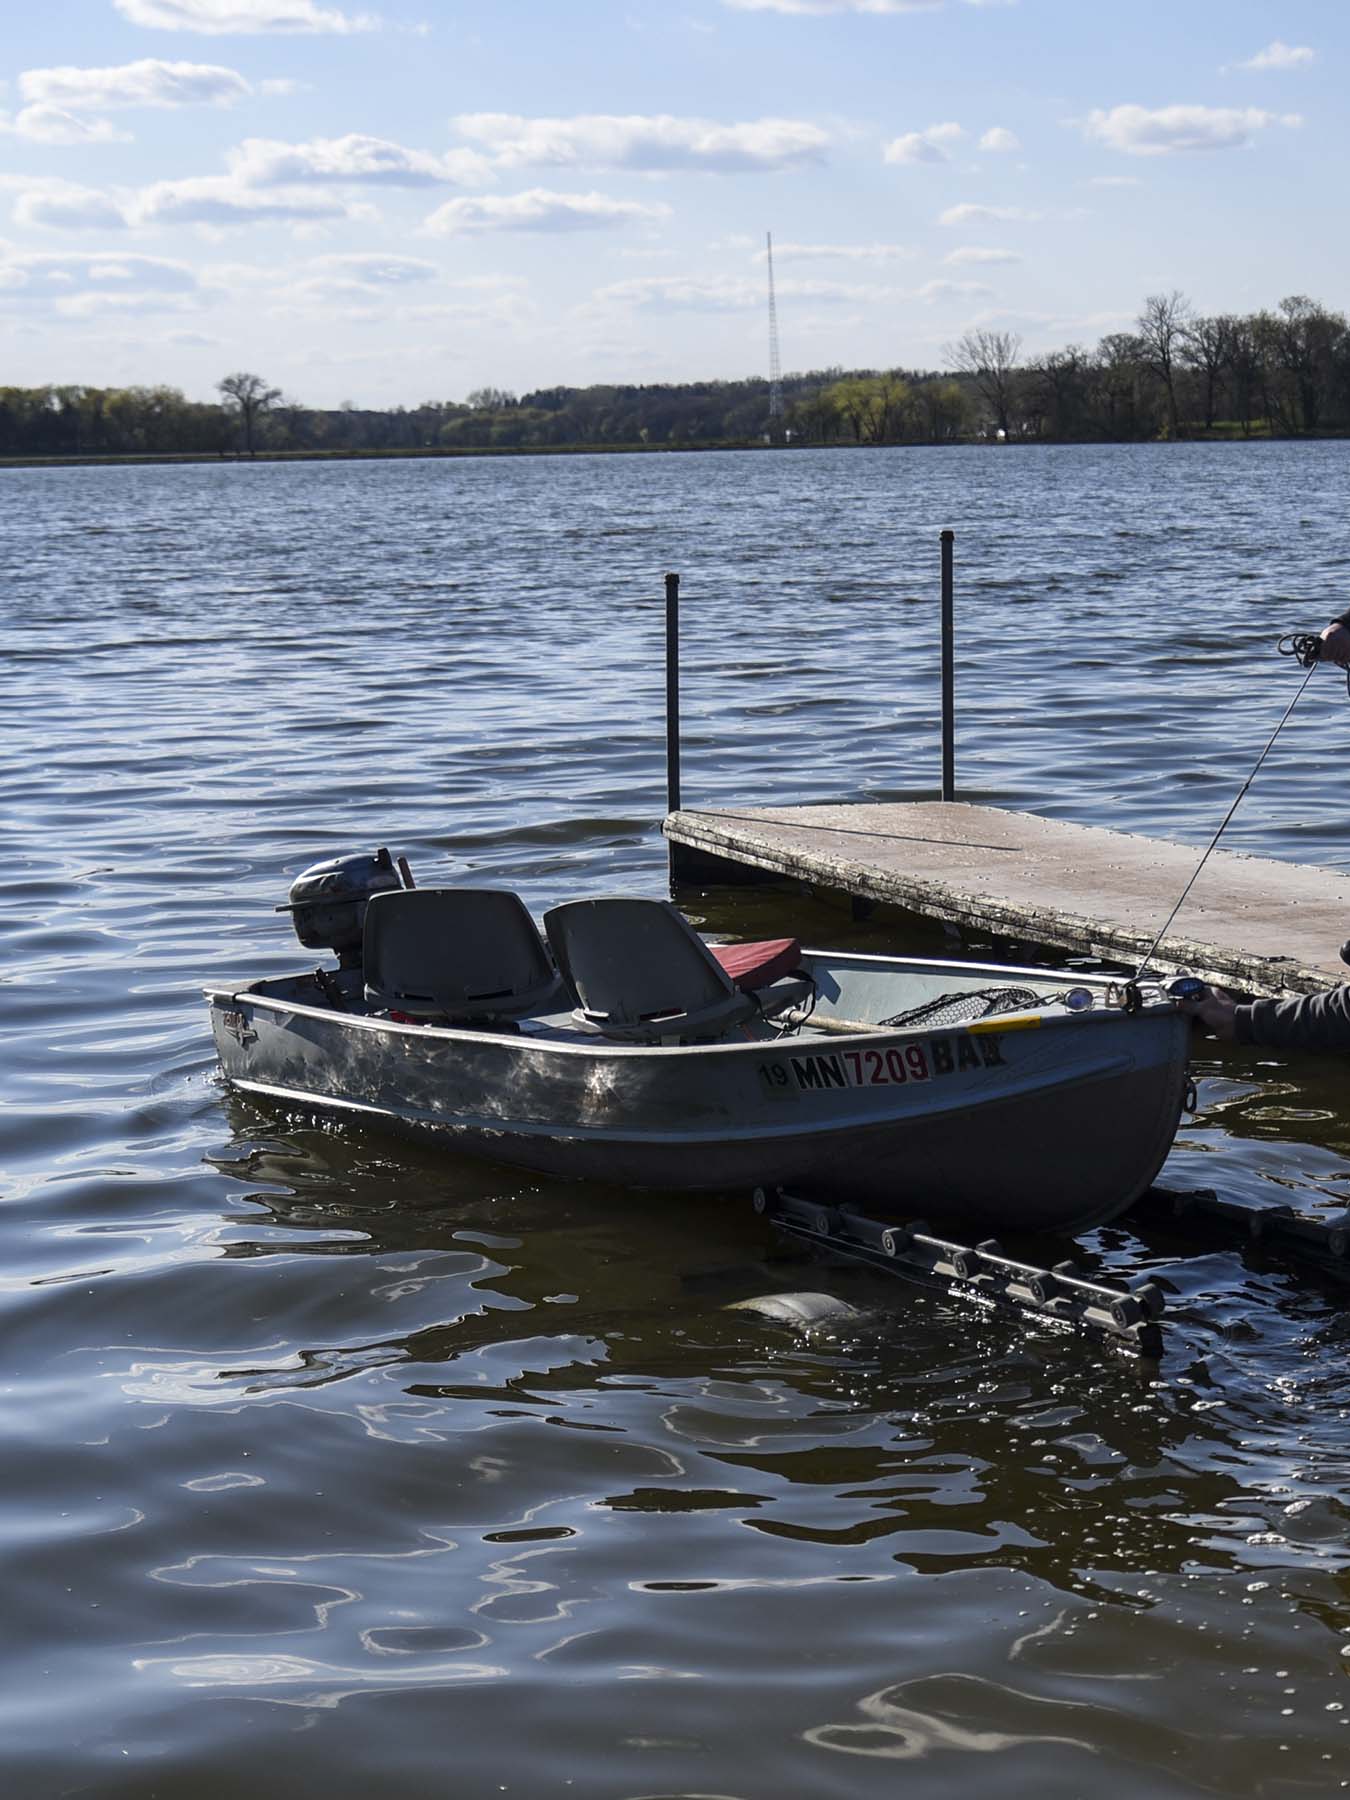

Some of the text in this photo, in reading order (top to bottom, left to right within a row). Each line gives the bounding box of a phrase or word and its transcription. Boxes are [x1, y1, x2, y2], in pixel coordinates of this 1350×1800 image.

[759, 1062, 788, 1087] 19
[790, 1056, 846, 1089] MN
[844, 1044, 930, 1085] 7209
